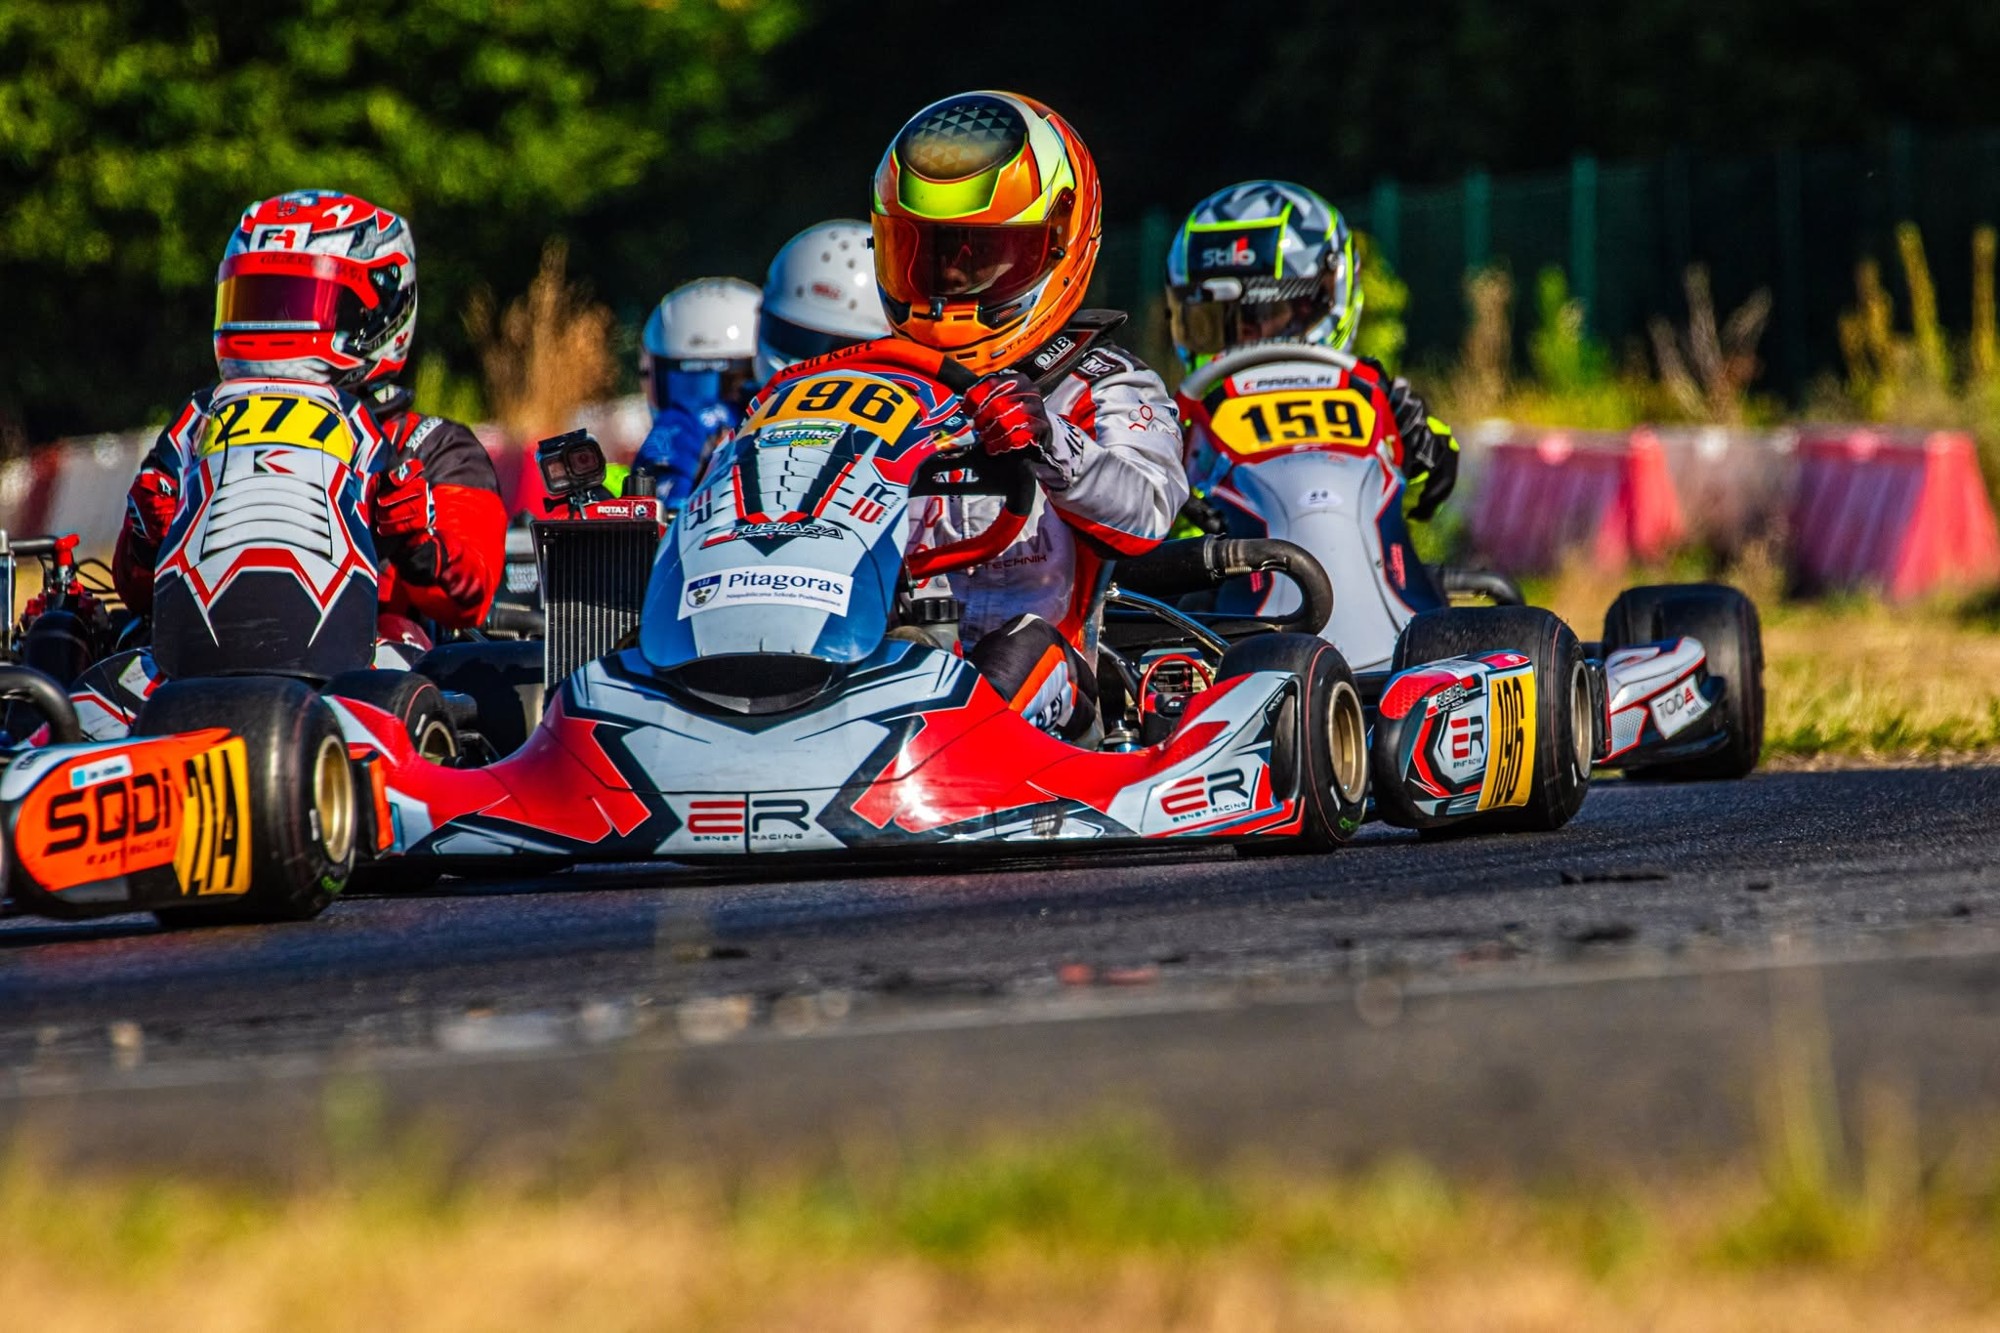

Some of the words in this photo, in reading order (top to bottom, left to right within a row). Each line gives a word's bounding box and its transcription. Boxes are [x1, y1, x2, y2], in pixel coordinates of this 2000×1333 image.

[763, 380, 906, 425] 196
[213, 397, 341, 446] 277
[1240, 399, 1366, 443] 159
[597, 505, 629, 514] ROTAX
[983, 554, 1048, 571] TECHNIK
[728, 571, 844, 595] Pitagoras
[1656, 687, 1695, 720] TODA
[1450, 715, 1485, 759] ER
[1160, 768, 1250, 817] ER
[687, 799, 810, 835] ER
[749, 832, 804, 840] RACING
